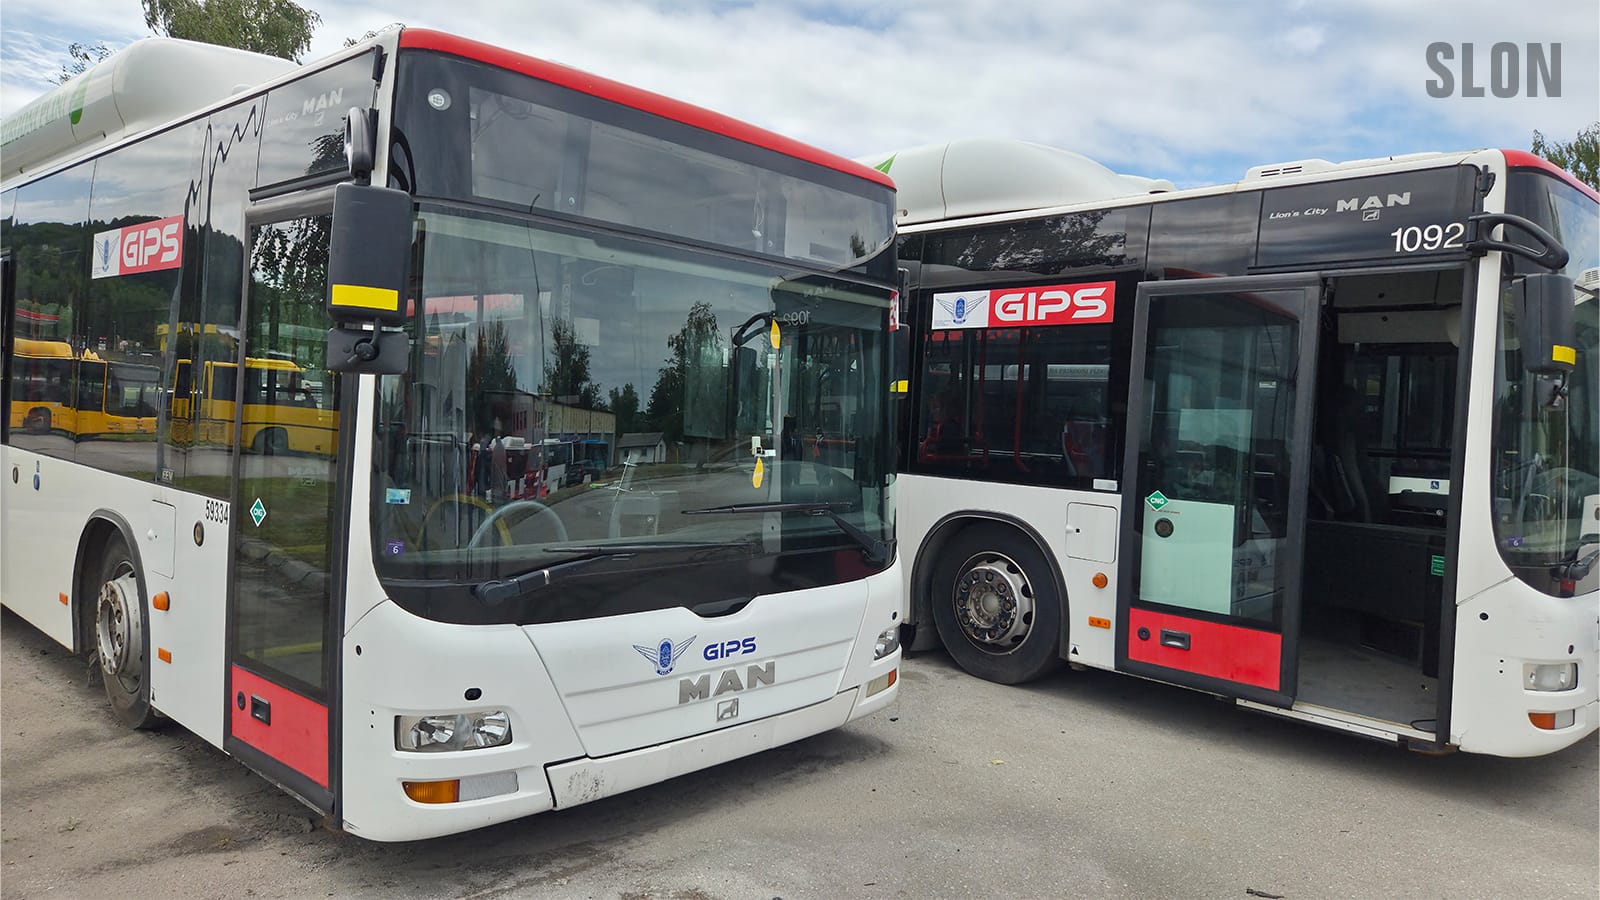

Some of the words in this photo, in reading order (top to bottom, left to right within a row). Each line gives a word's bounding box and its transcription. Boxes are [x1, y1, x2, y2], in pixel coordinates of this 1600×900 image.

[302, 87, 343, 116] MAN
[1269, 210, 1300, 220] Lion's
[1304, 207, 1329, 217] City
[1336, 192, 1411, 212] MAN
[122, 223, 179, 267] GIPS
[1390, 222, 1465, 252] 1092
[995, 287, 1107, 321] GIPS
[205, 500, 229, 524] 59334
[1150, 497, 1165, 505] CNG
[392, 545, 399, 554] 6
[703, 636, 757, 661] GIPS
[679, 661, 775, 704] MAN
